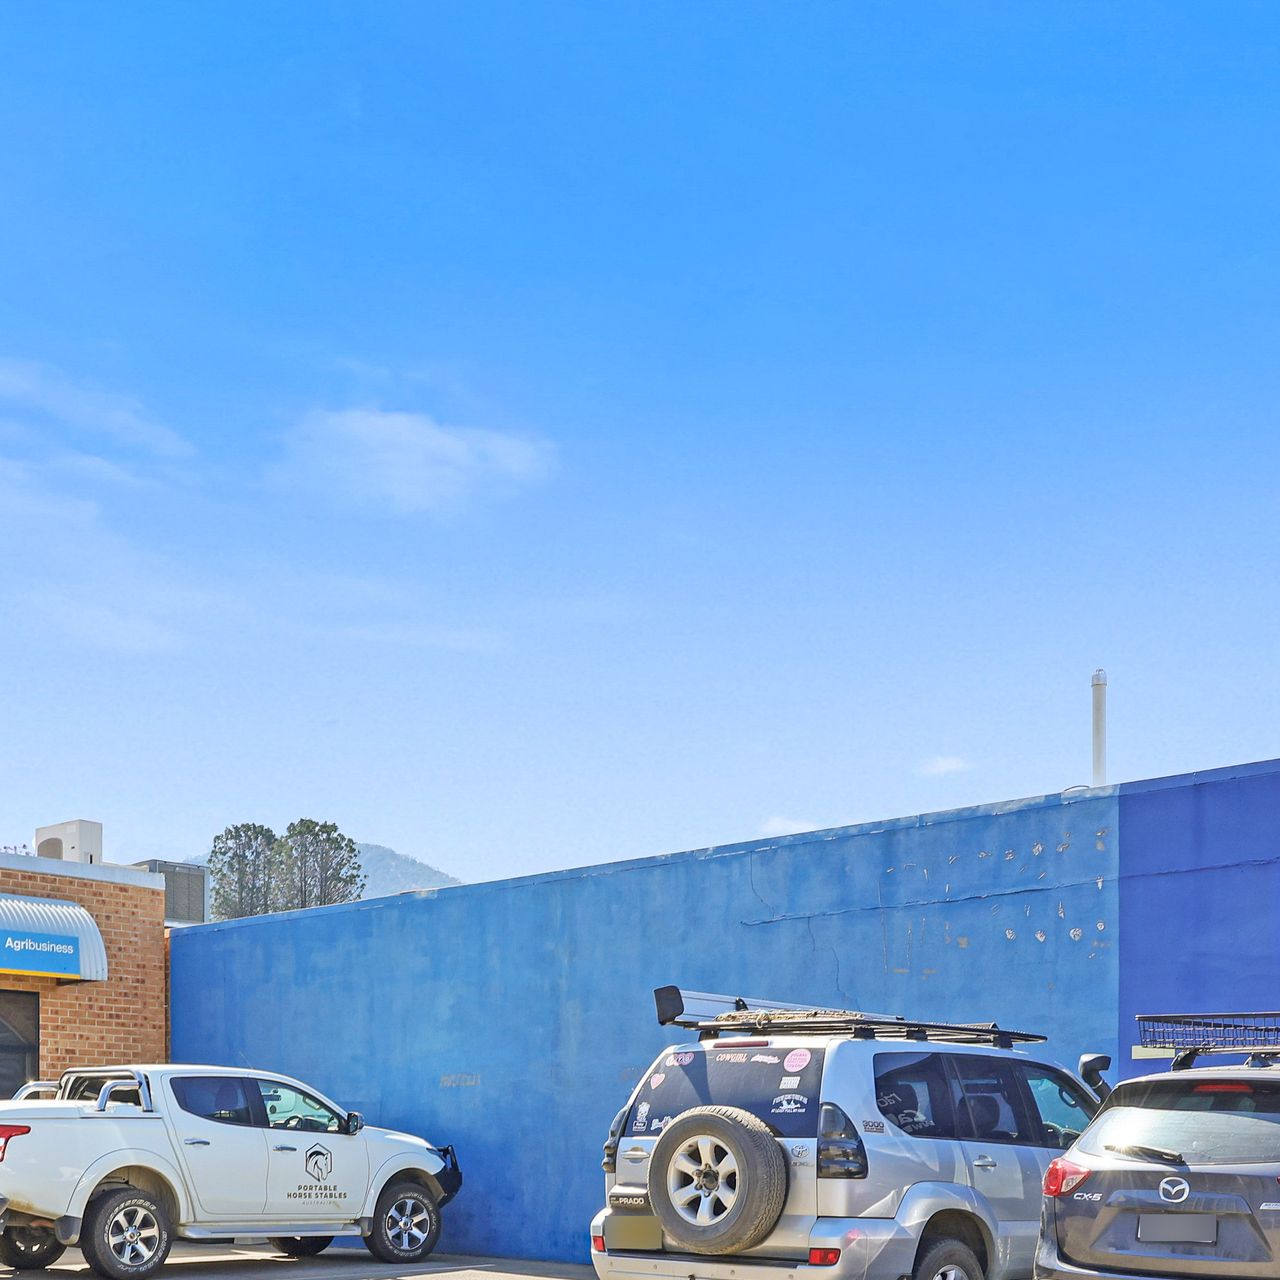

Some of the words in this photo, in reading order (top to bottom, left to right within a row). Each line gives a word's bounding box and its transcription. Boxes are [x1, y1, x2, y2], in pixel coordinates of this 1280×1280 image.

[4, 936, 74, 954] Agribusiness
[715, 1053, 748, 1063] COWGIRL
[862, 1119, 885, 1129] 3000
[297, 1184, 338, 1192] PORTABLE
[619, 1197, 645, 1205] PRADO
[1073, 1192, 1102, 1201] CX-5
